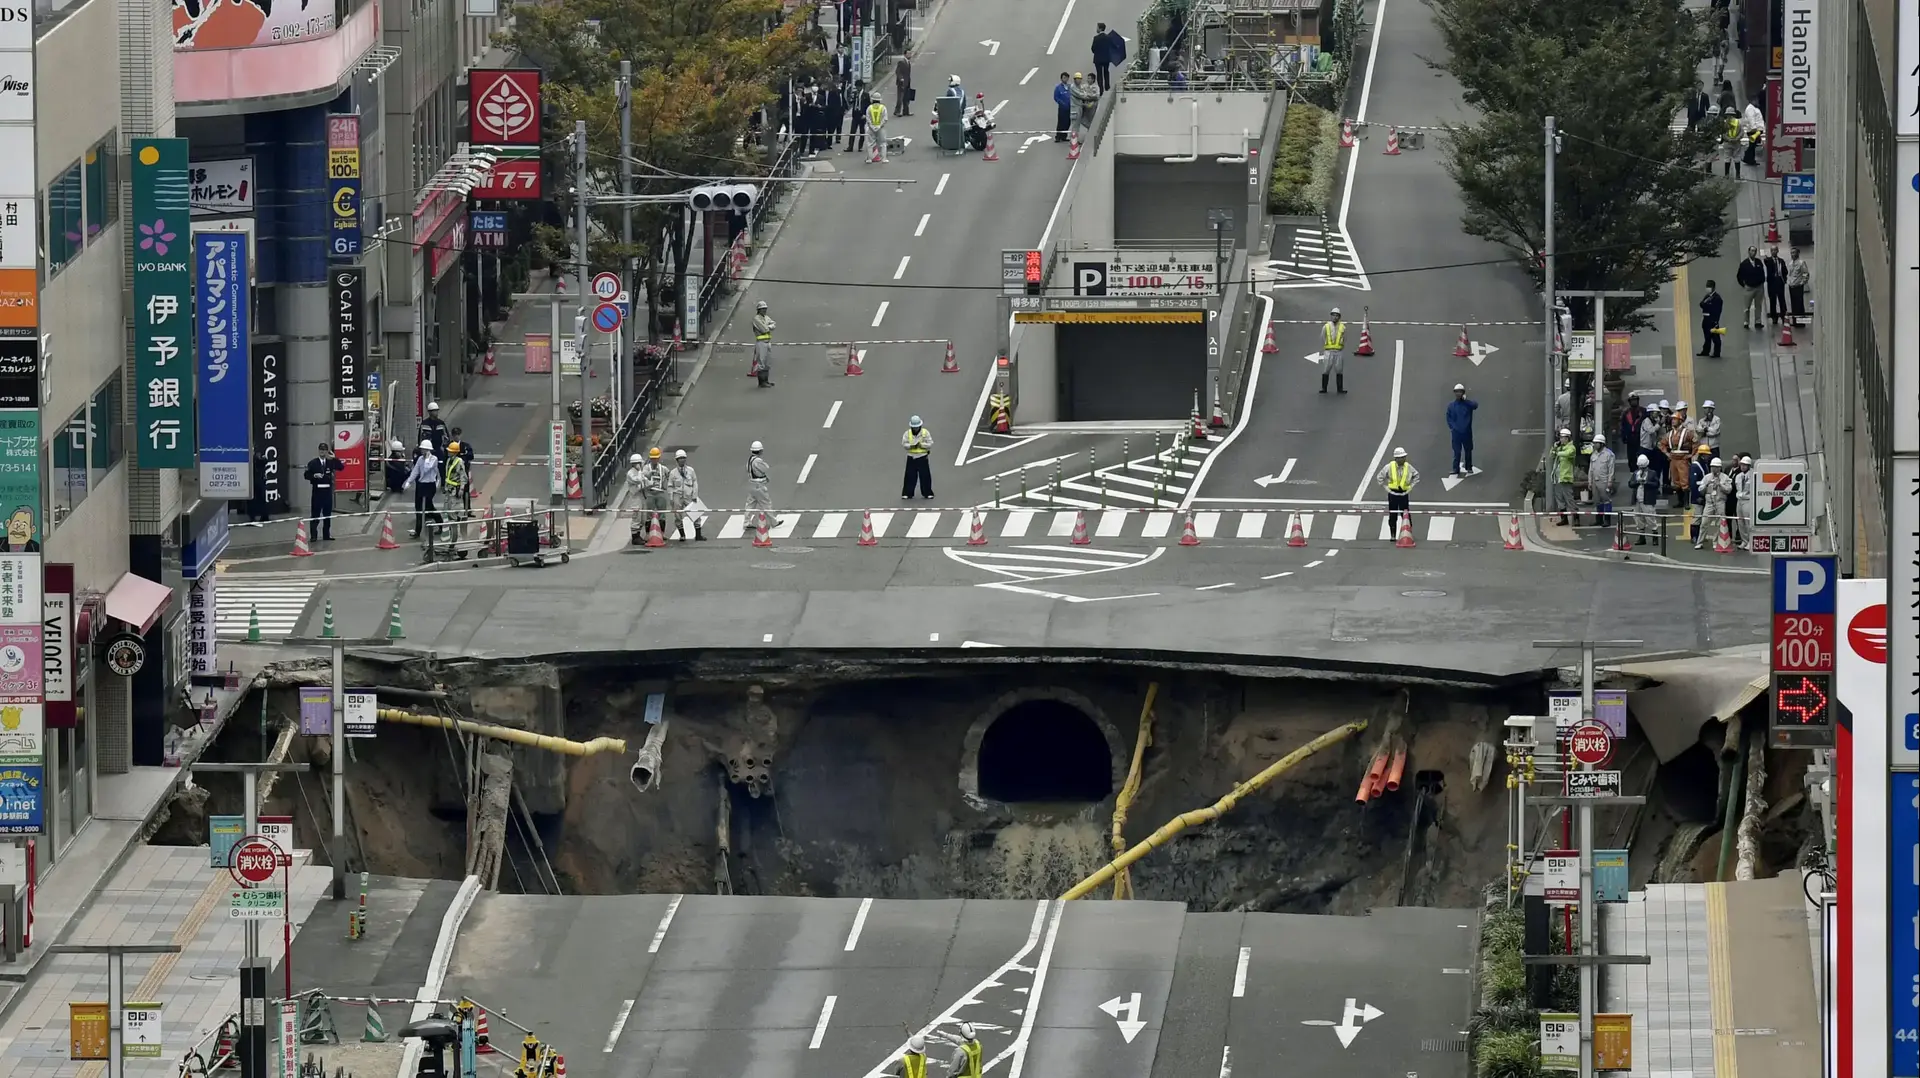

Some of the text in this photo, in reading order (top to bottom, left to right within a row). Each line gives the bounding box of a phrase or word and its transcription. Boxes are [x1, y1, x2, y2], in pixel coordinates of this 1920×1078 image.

[1791, 9, 1811, 116] HanaTour
[3, 80, 29, 91] Wise
[330, 119, 357, 132] 24h
[331, 164, 357, 177] 100円
[1250, 167, 1257, 185] 出口
[191, 184, 238, 202] ホルモン
[6, 202, 17, 226] 村田
[473, 216, 504, 229] たばこ
[335, 237, 357, 253] 6F
[473, 232, 504, 246] ATM
[137, 262, 187, 272] IYO BANK
[1109, 263, 1213, 273] 地下送迎場・駐車場
[598, 281, 615, 294] 40
[1079, 268, 1103, 296] P
[230, 241, 239, 349] Dramatic Communication
[1010, 297, 1040, 308] 博多駅
[205, 241, 229, 383] アパマンショップ
[340, 289, 355, 333] CAFÉ
[1209, 310, 1218, 321] P
[341, 337, 353, 350] de
[1208, 336, 1218, 355] 入口
[146, 294, 181, 450] 伊予銀行
[341, 354, 356, 395] CRIÉ
[263, 354, 280, 416] CAFÉ
[344, 412, 354, 420] 1F
[264, 421, 278, 440] de
[6, 449, 37, 457] 株式会社
[265, 445, 281, 503] CRIÉ
[345, 481, 355, 489] 1F
[1753, 538, 1809, 550] たばこ 酒 ATM
[2, 560, 13, 618] 若者未来塾
[1785, 560, 1827, 611] P
[1784, 617, 1824, 636] 20分
[1776, 638, 1831, 667] 100円
[27, 680, 38, 690] 3F
[1574, 737, 1606, 752] 消火栓
[1570, 773, 1618, 786] とみや歯科
[240, 855, 273, 871] 消火栓
[243, 891, 282, 900] むらつ歯科
